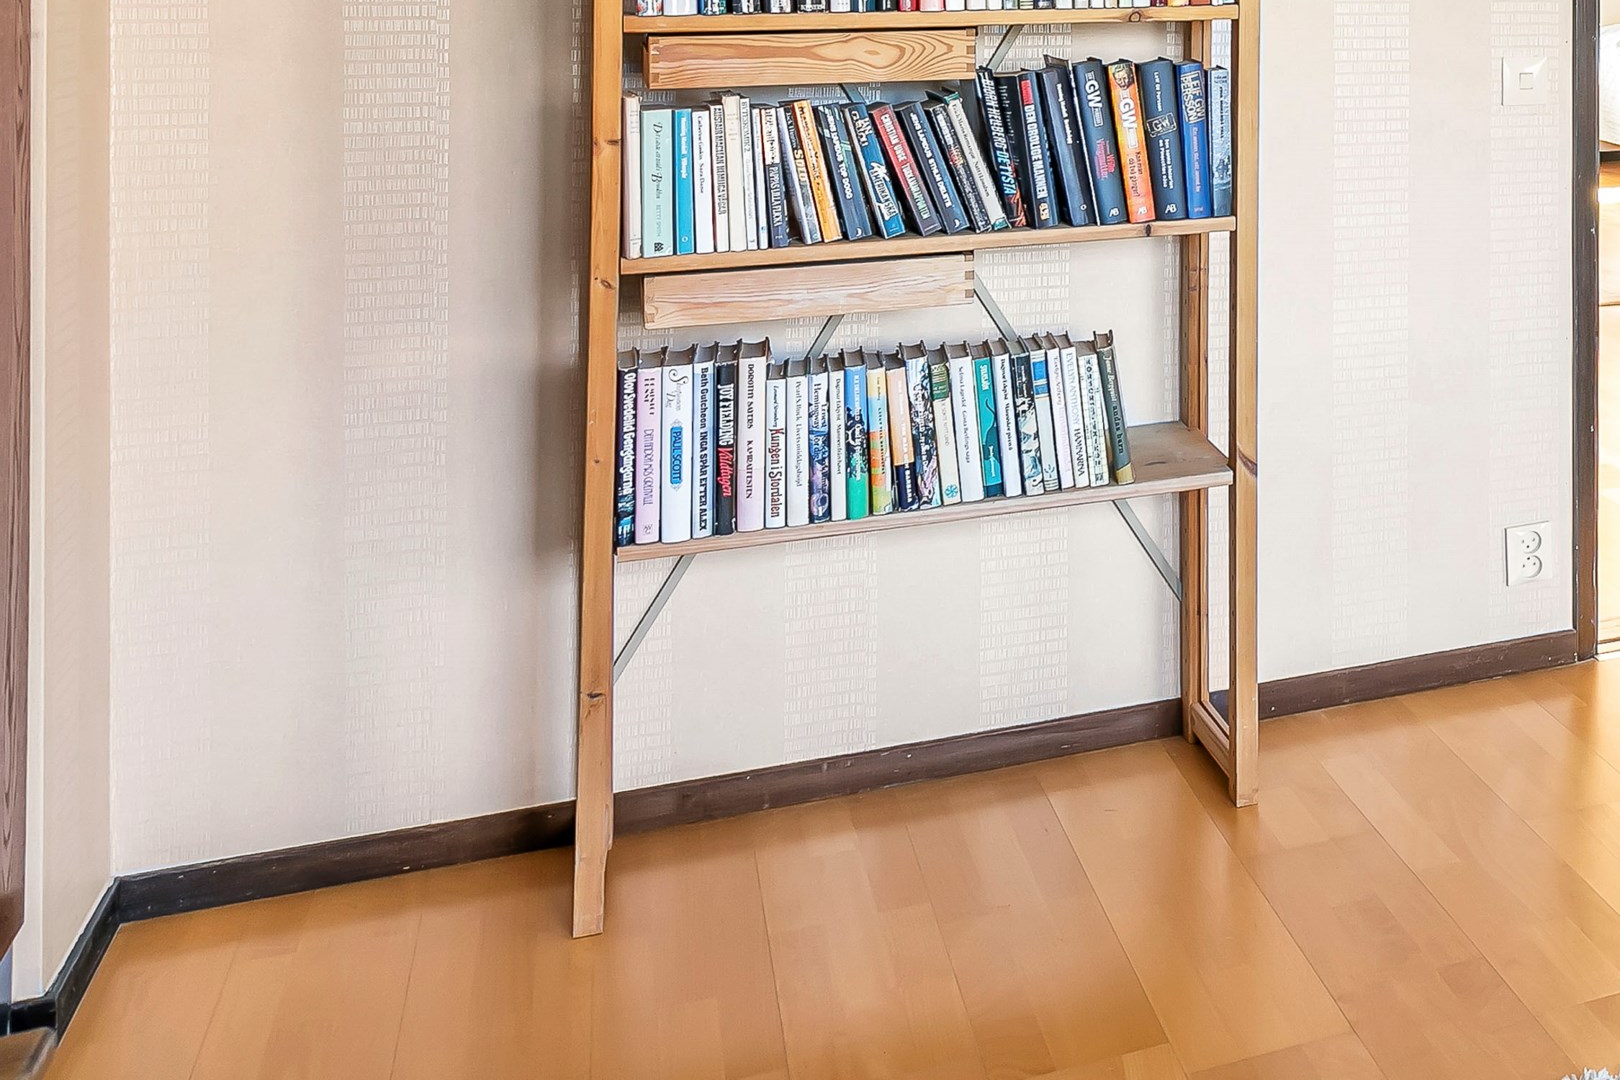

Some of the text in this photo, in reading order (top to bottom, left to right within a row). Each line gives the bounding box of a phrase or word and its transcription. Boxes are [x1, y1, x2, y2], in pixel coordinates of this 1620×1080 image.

[1085, 79, 1102, 108] GW
[1181, 77, 1197, 123] PERSSON
[1191, 73, 1201, 98] LEIF
[1024, 105, 1037, 124] DEN
[1119, 98, 1137, 129] GW
[989, 109, 1004, 149] HELLBERG
[1028, 124, 1042, 161] OROLIGE
[996, 151, 1007, 166] DE
[768, 166, 782, 188] PAPPAS
[999, 165, 1016, 194] TYSTA
[1034, 161, 1048, 199] MANNEN
[623, 372, 636, 394] Olov
[701, 367, 709, 387] Beth
[718, 383, 734, 401] JOY
[719, 401, 733, 446] FIELDING
[672, 431, 682, 481] PAUL SCOTT
[700, 431, 708, 452] INGA
[768, 428, 785, 464] Kungen
[700, 453, 710, 476] SPÅR
[769, 470, 783, 518] Stordalen
[699, 508, 707, 531] ALEX
